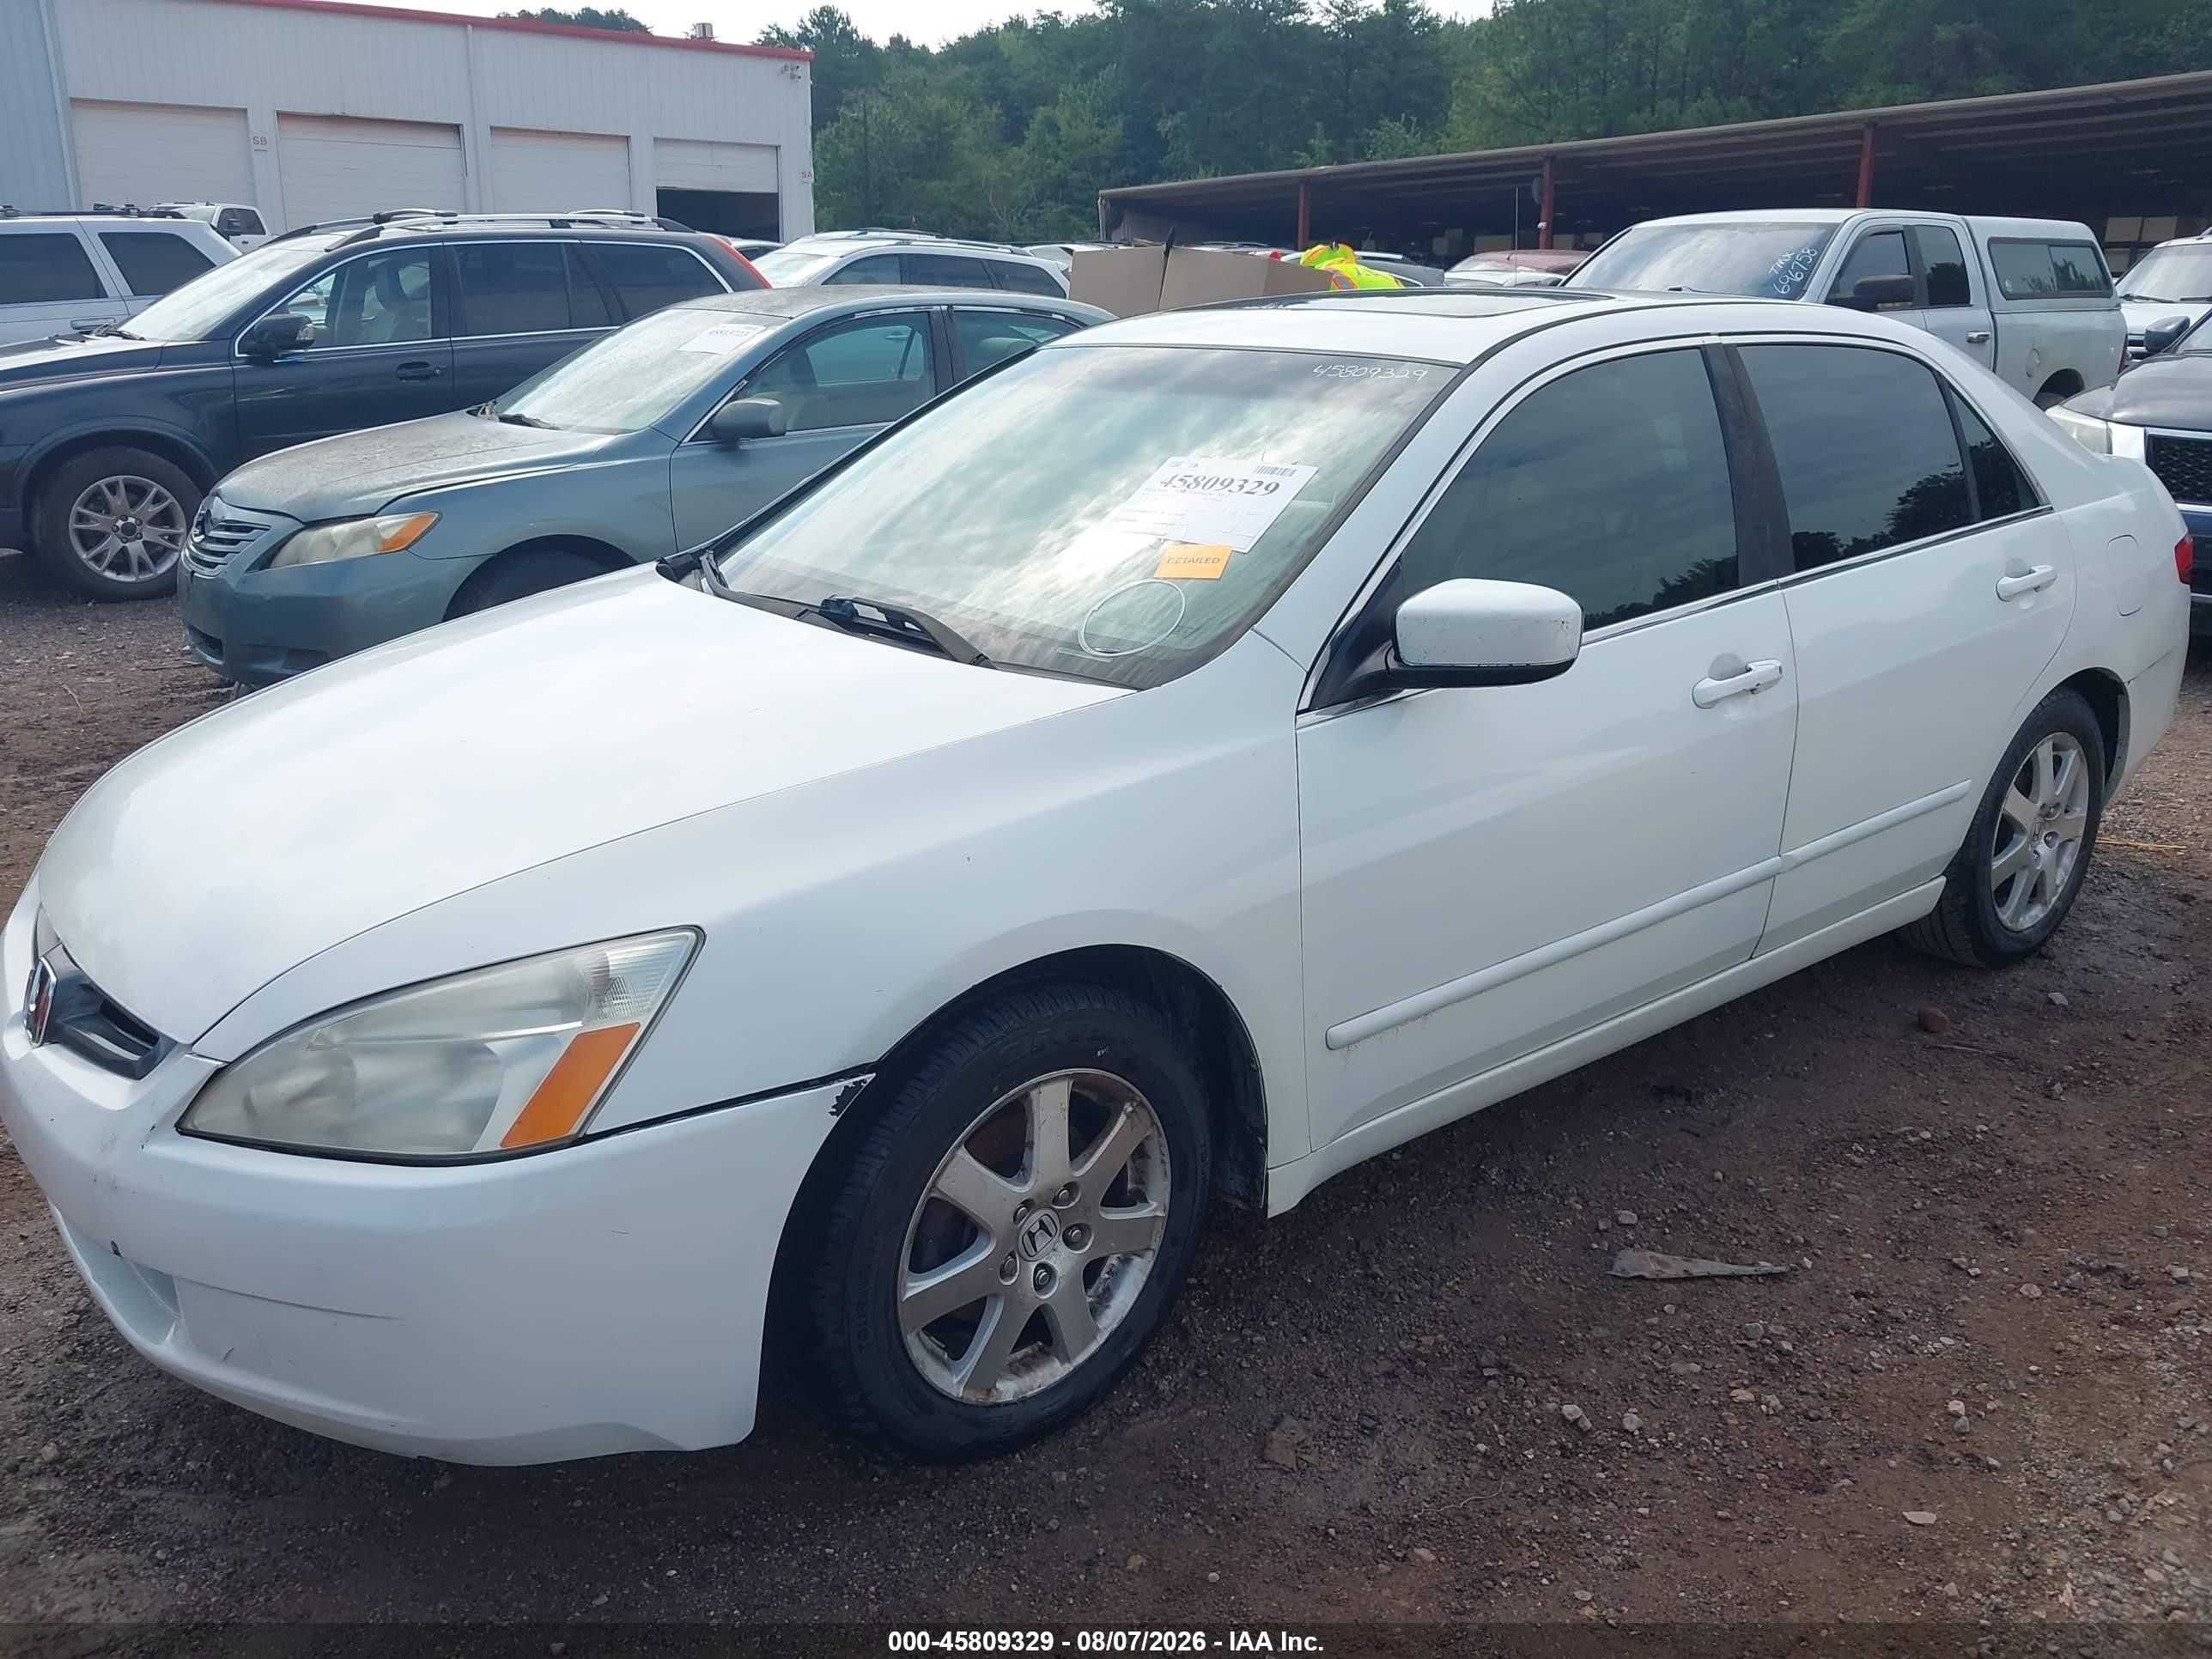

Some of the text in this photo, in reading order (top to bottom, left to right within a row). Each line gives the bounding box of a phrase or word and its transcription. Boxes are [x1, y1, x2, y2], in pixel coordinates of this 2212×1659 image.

[1772, 246, 1818, 295] 696758
[1313, 364, 1428, 380] 45809329
[1160, 473, 1280, 496] 45809329
